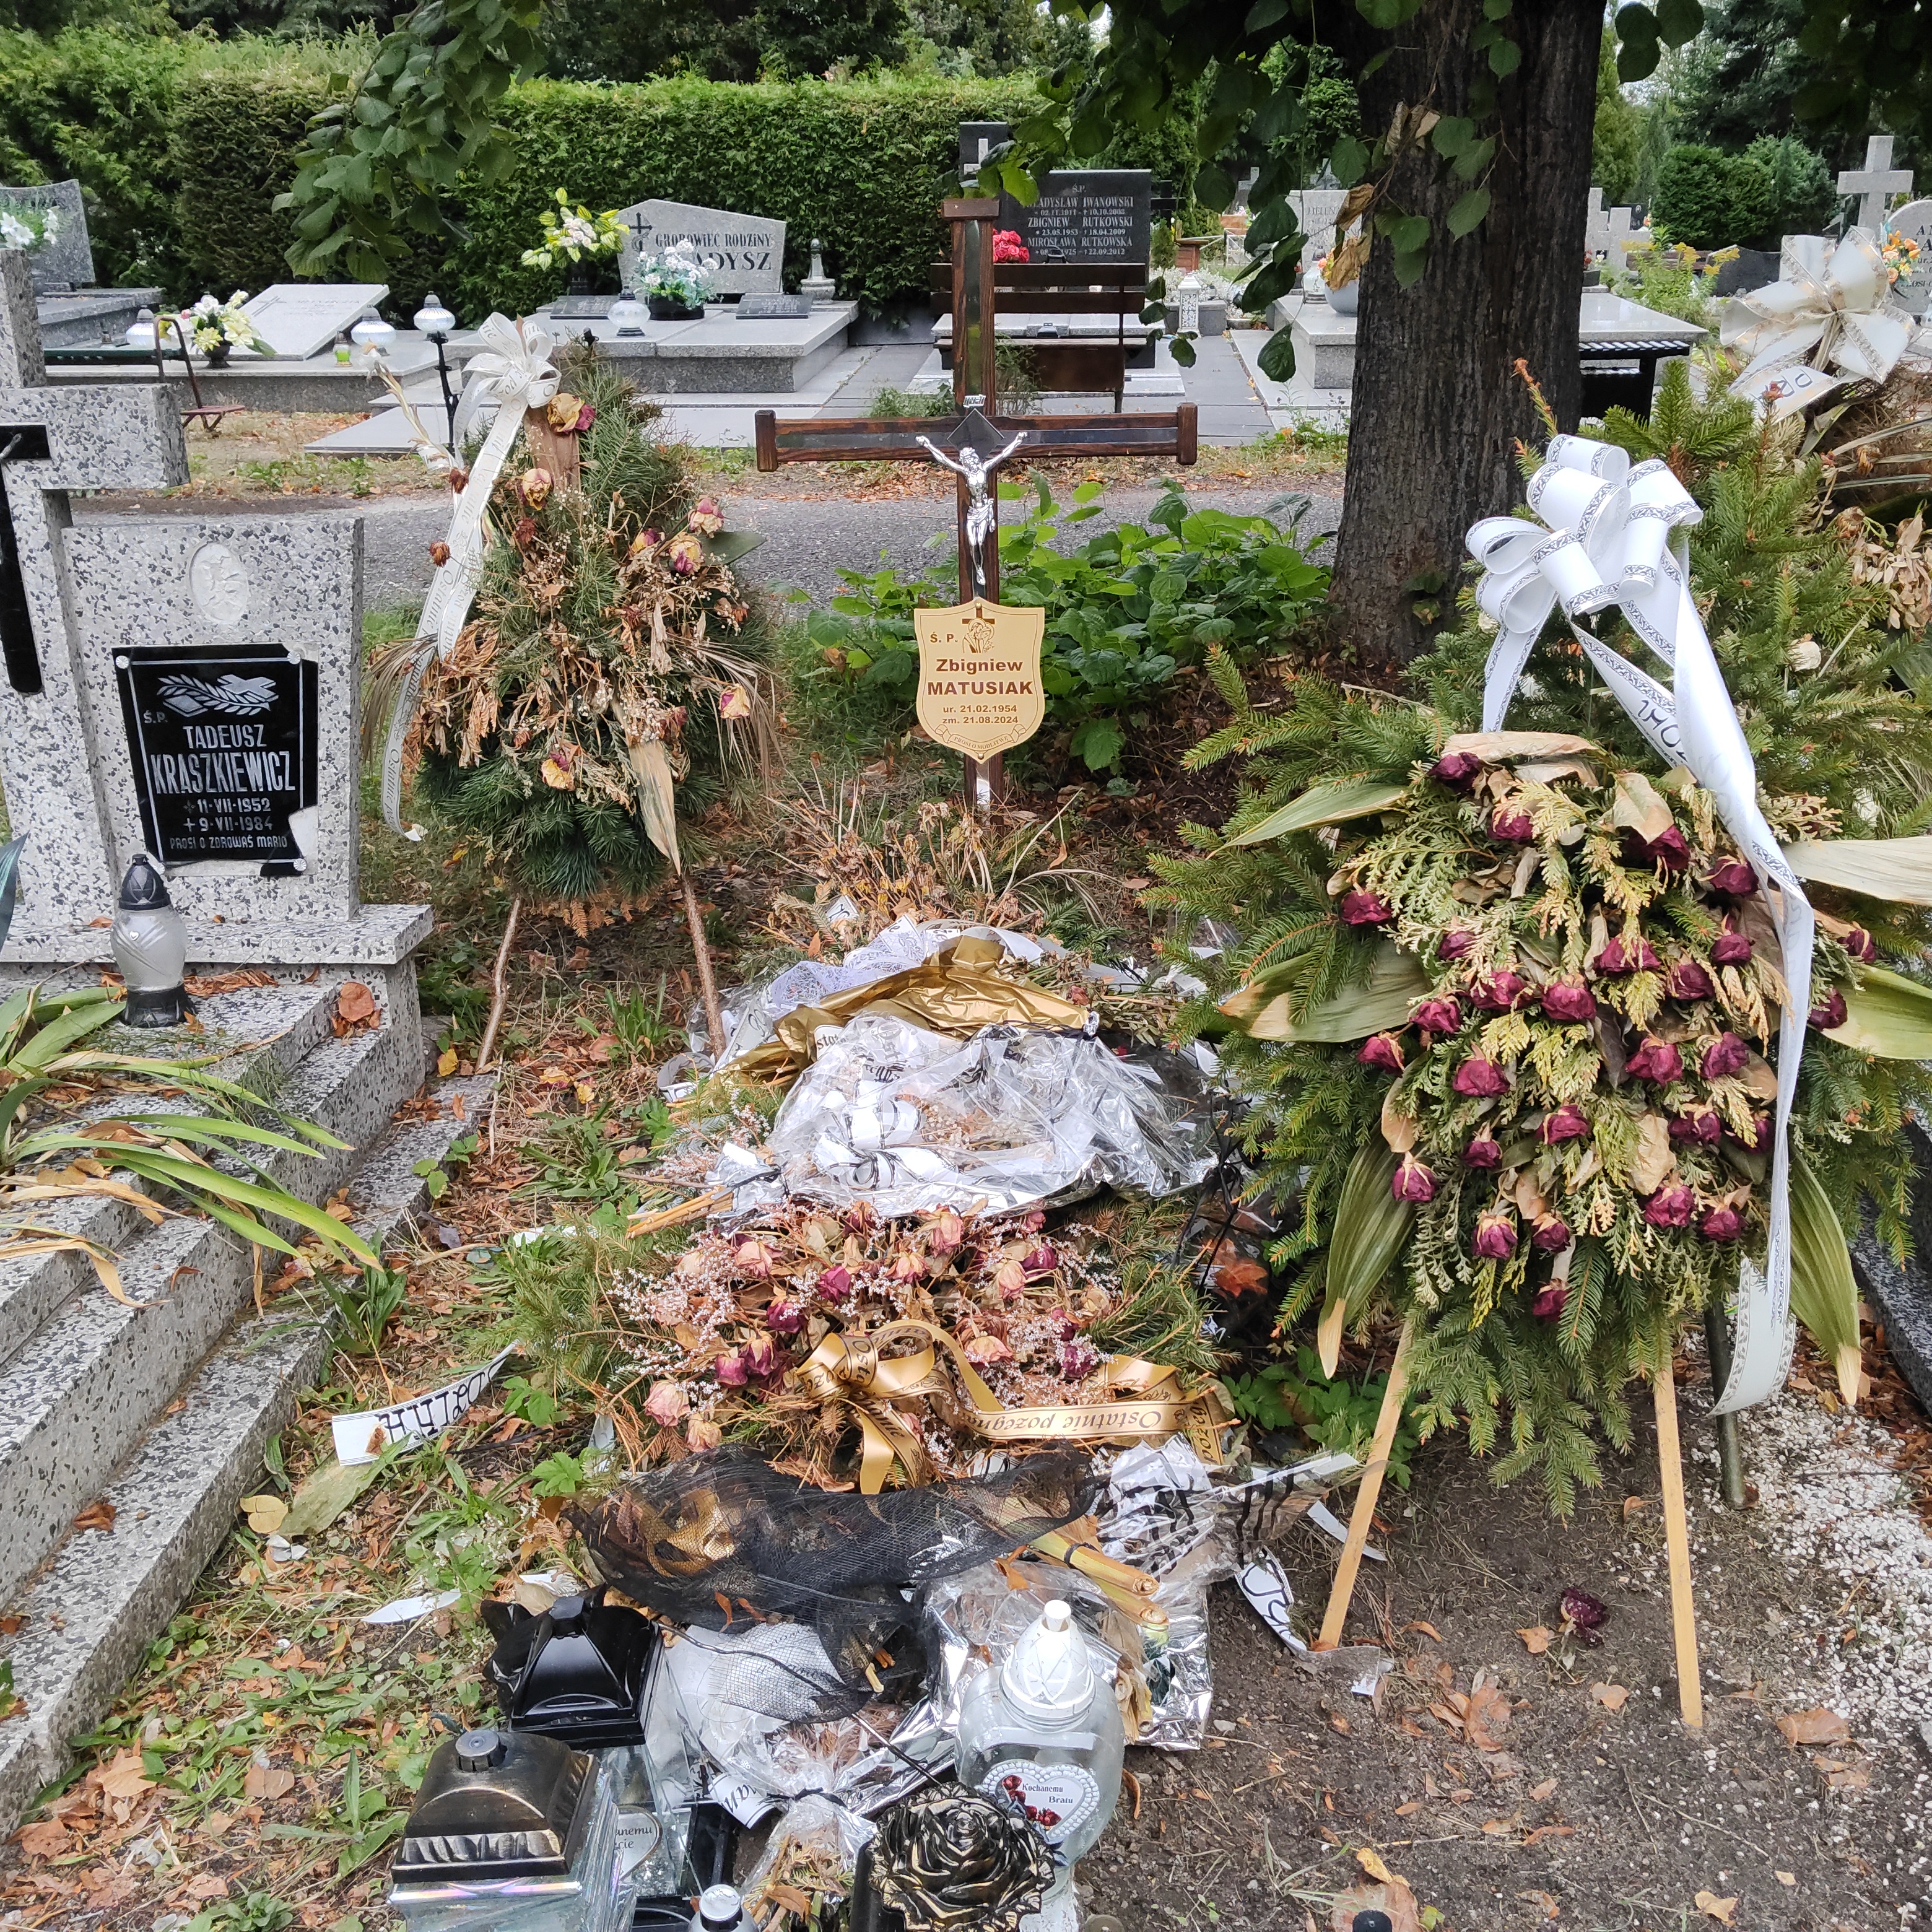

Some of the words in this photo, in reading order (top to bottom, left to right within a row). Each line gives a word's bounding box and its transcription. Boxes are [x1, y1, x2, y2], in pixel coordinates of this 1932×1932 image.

[1082, 196, 1134, 207] IWANOWSKI
[1028, 217, 1069, 227] ZBIGNIEW
[1082, 216, 1133, 227] RUTKOWSKI
[1028, 237, 1077, 247] MIROSŁAWA
[1081, 237, 1133, 247] RUTKOWSKA
[936, 658, 1024, 675] Zbigniew
[928, 681, 1033, 695] MATUSIAK
[960, 705, 1017, 713] 21.02.1954
[963, 716, 1018, 724] 21.08.2024
[183, 724, 267, 749] TADEUSZ
[150, 751, 296, 794] KRASZKIEWICZ
[169, 837, 197, 850] PROSI
[199, 838, 206, 849] O
[209, 835, 254, 849] ZDROWAŚ
[256, 836, 288, 848] MARIO
[1063, 1411, 1162, 1432] Ostatnie
[1022, 1783, 1063, 1793] Kochanemu
